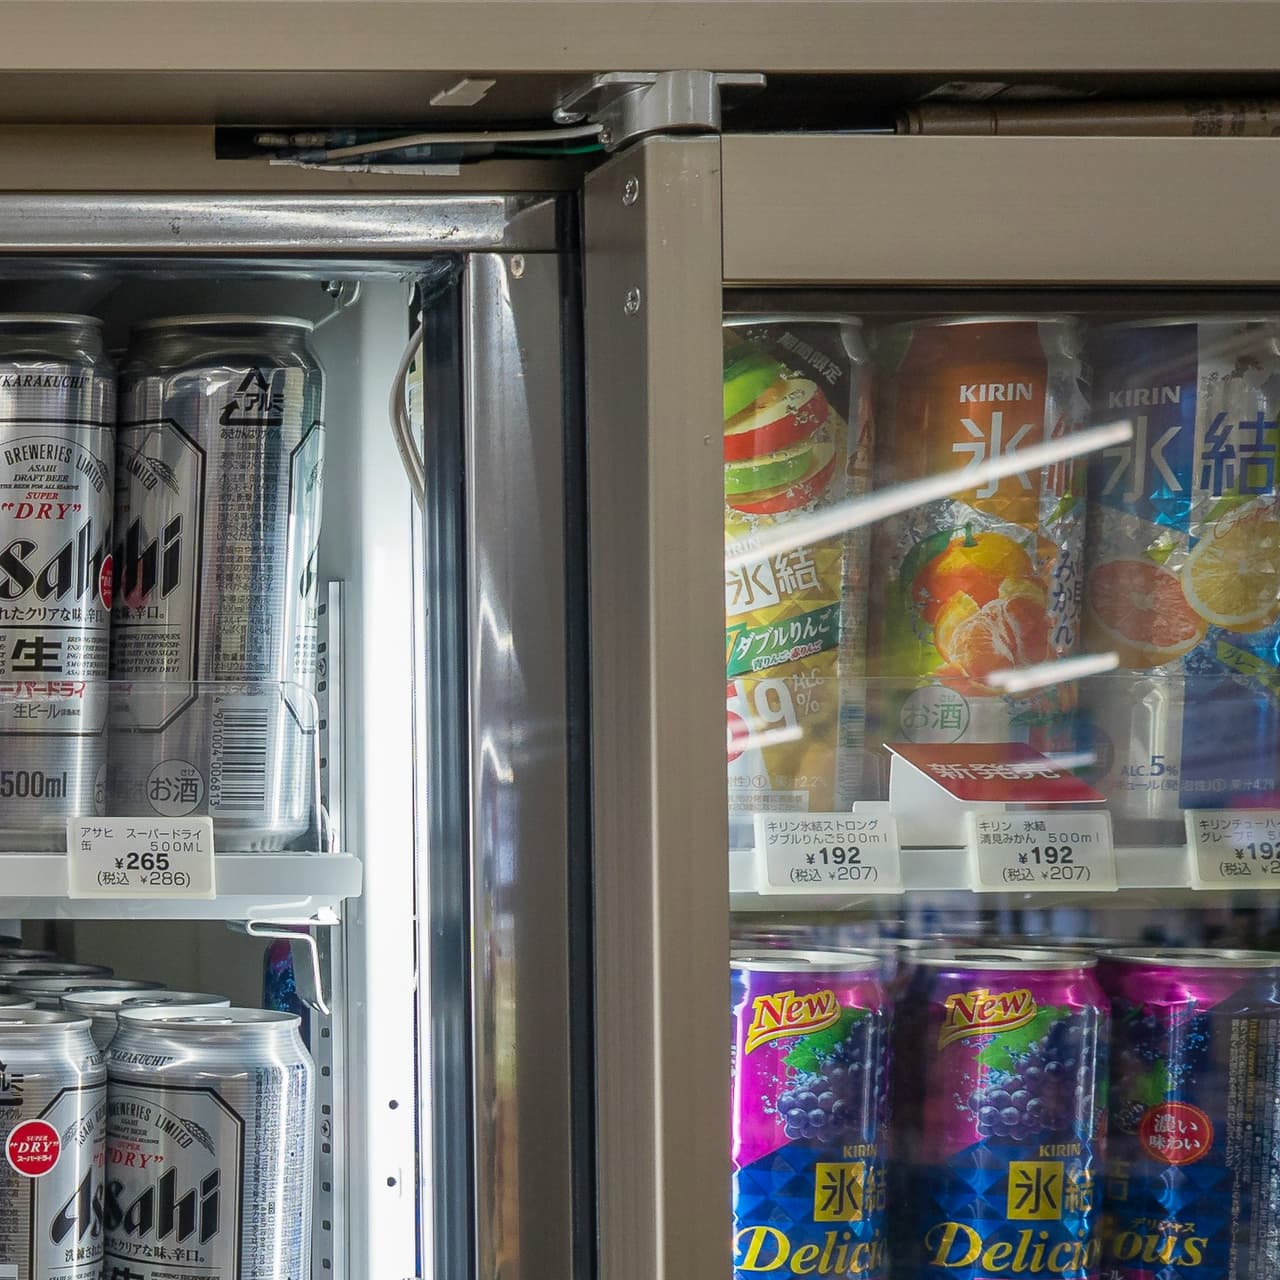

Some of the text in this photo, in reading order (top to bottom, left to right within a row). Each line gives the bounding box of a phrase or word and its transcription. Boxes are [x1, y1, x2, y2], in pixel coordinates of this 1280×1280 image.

[960, 382, 1032, 402] KIRIN
[1108, 385, 1181, 406] KIRIN
[4, 446, 72, 466] BREWERIES
[12, 636, 62, 672] 生
[0, 770, 67, 798] 500ml
[148, 838, 202, 852] 500ML
[1019, 846, 1073, 864] ¥192
[115, 853, 169, 870] ¥265
[807, 847, 861, 864] ¥192
[754, 992, 835, 1025] New
[945, 992, 1030, 1025] New
[155, 1115, 193, 1149] LIMITED
[1155, 1115, 1198, 1132] 濃い
[1040, 1145, 1080, 1156] KIRIN
[1149, 1135, 1200, 1150] 味わい
[1015, 1168, 1056, 1214] 氷
